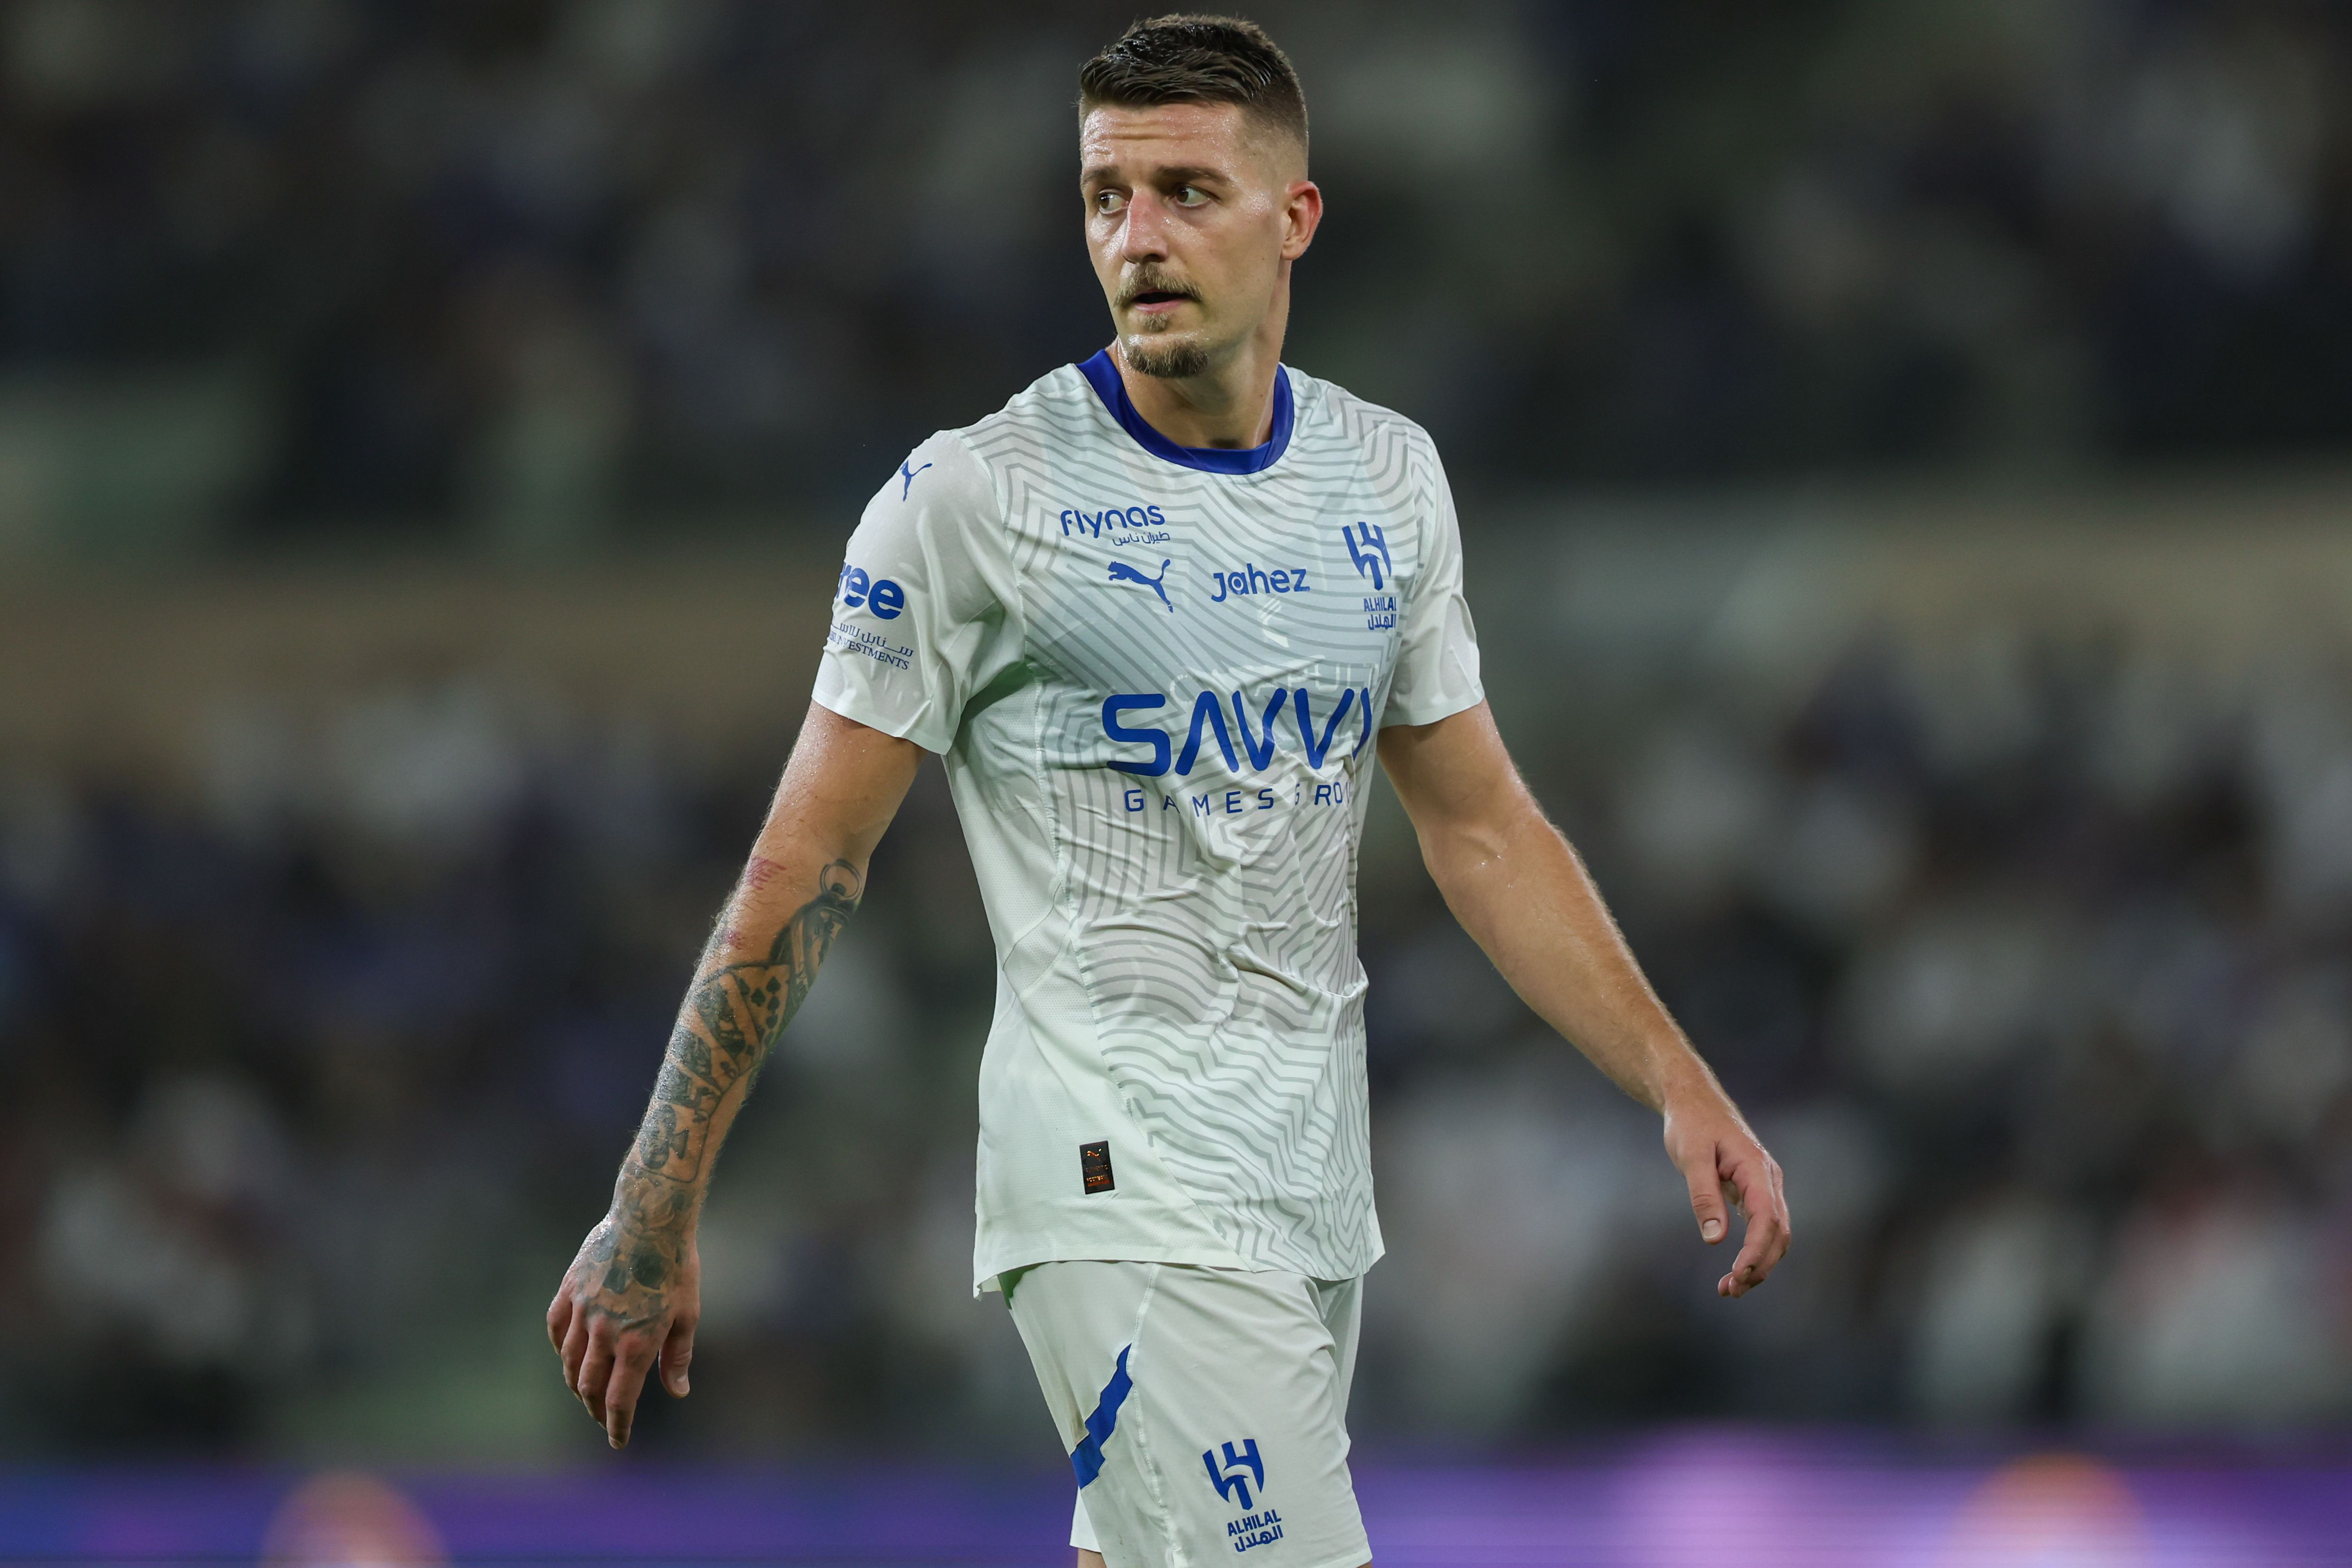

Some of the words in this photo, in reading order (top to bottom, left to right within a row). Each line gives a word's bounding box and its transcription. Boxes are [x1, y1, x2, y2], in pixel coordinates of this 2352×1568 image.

[1060, 505, 1165, 539] flynas
[1112, 533, 1139, 546] ناس
[1141, 531, 1171, 544] طيران
[1368, 614, 1396, 630] الهلال
[862, 632, 914, 657] سنابل
[1124, 788, 1274, 817] GAMES
[1227, 1509, 1282, 1537] ALHILAL
[1234, 1524, 1284, 1552] الهلال
